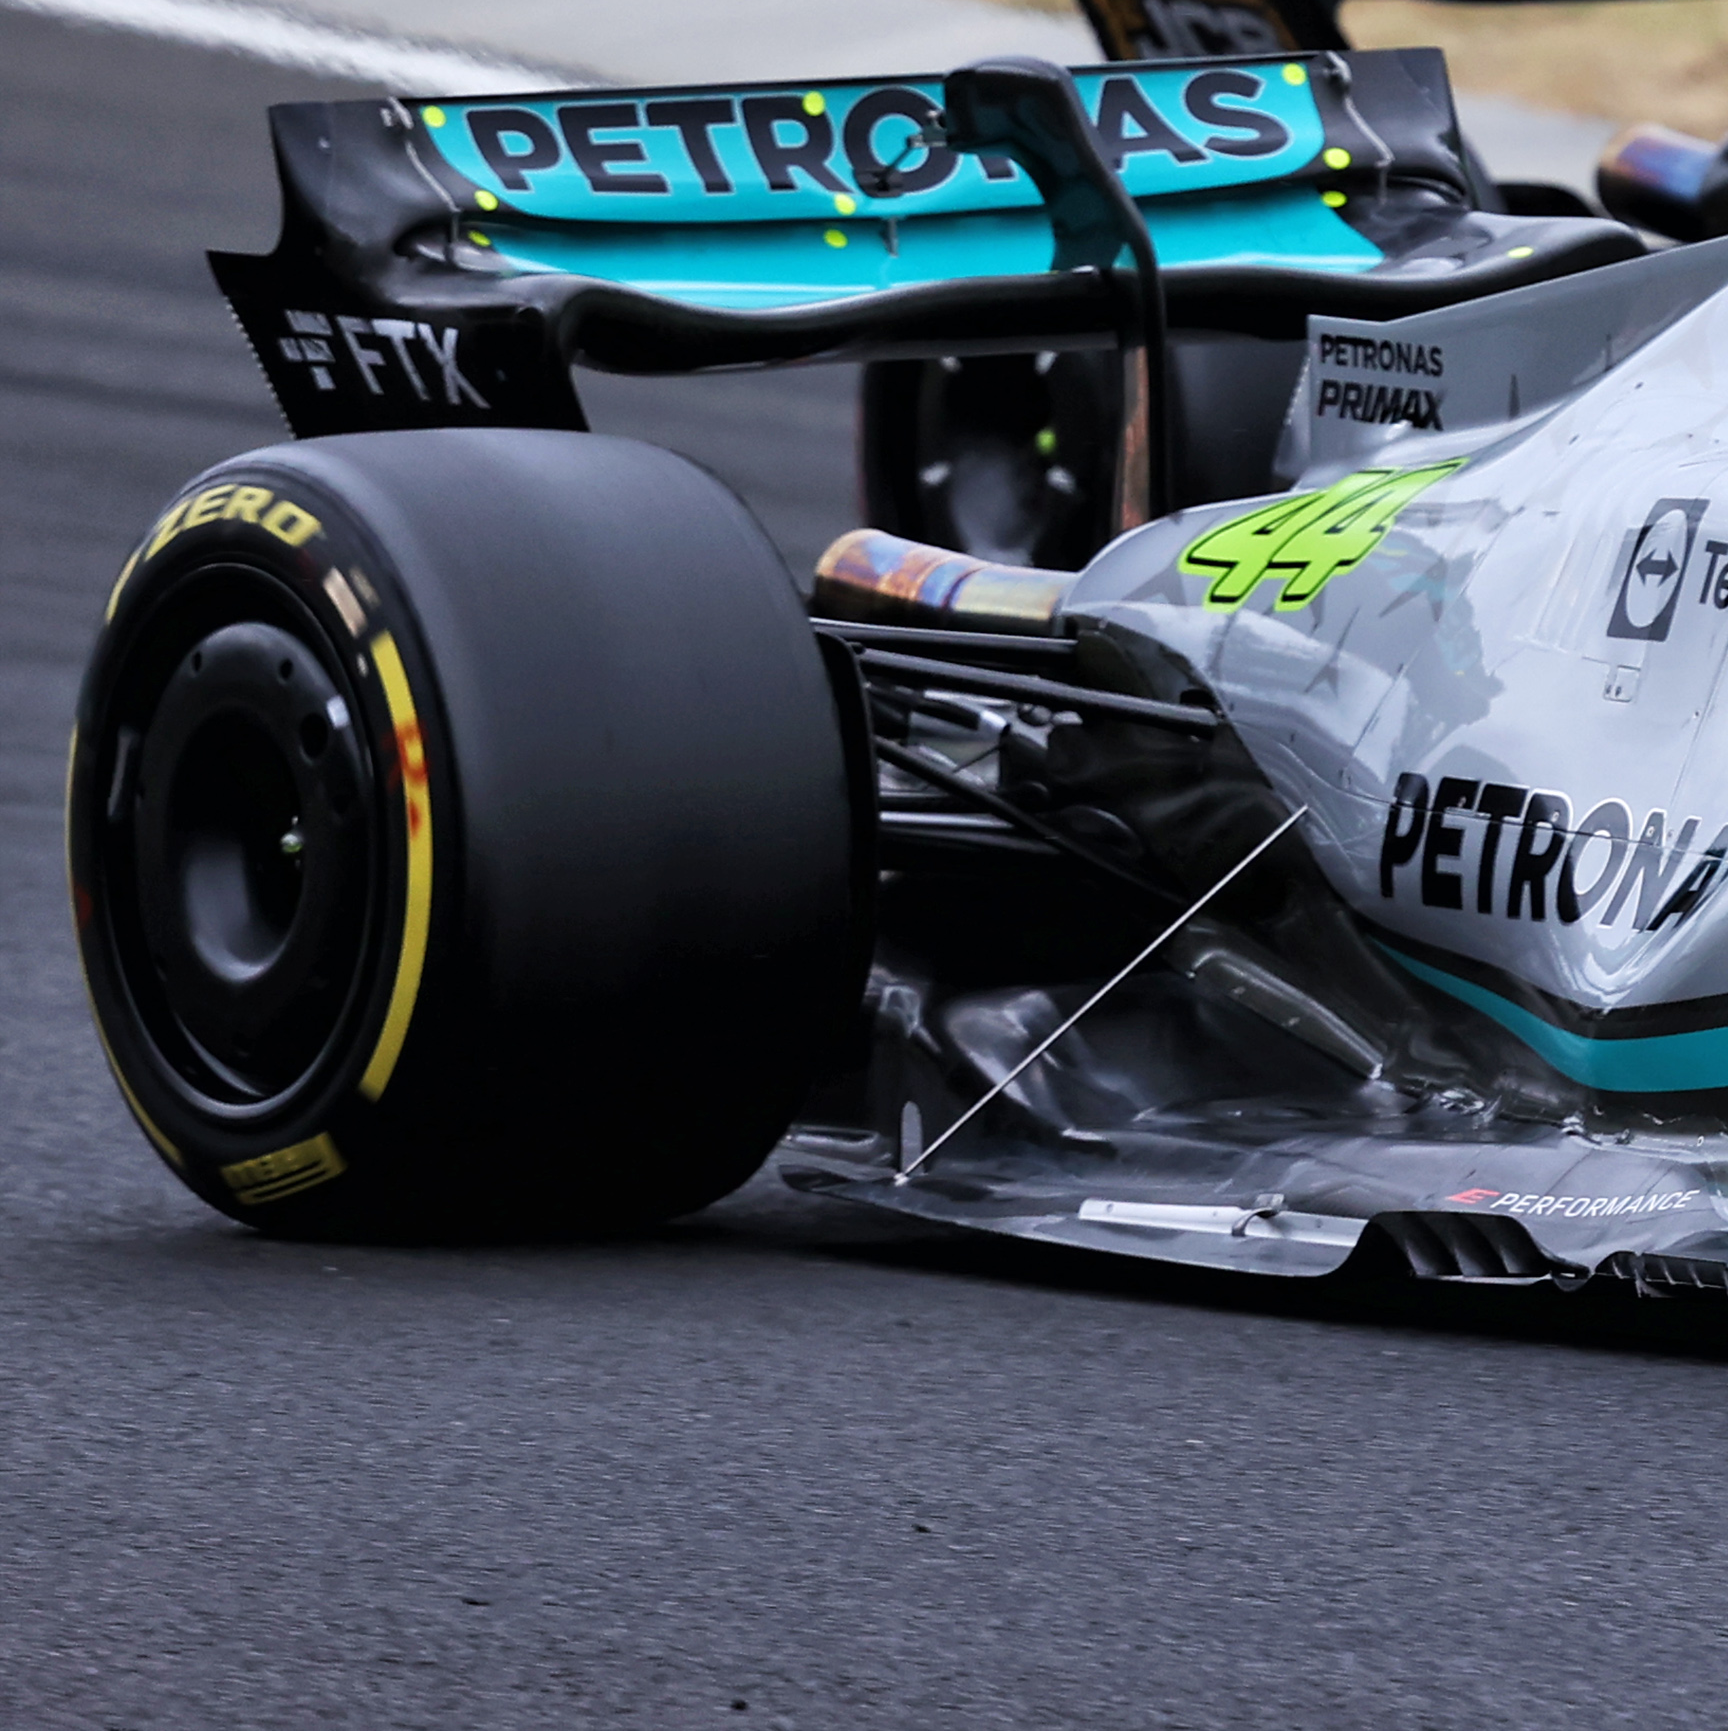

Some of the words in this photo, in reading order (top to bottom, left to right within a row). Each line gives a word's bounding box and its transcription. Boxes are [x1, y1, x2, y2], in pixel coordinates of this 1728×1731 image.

[464, 70, 1294, 198] PETROAS
[335, 314, 492, 410] FTX
[1319, 332, 1444, 377] PETRONAS
[1316, 378, 1446, 432] PRIMAX
[144, 483, 326, 562] ZERO
[1178, 456, 1472, 613] 44
[1490, 1190, 1701, 1219] PERFORMANCE
